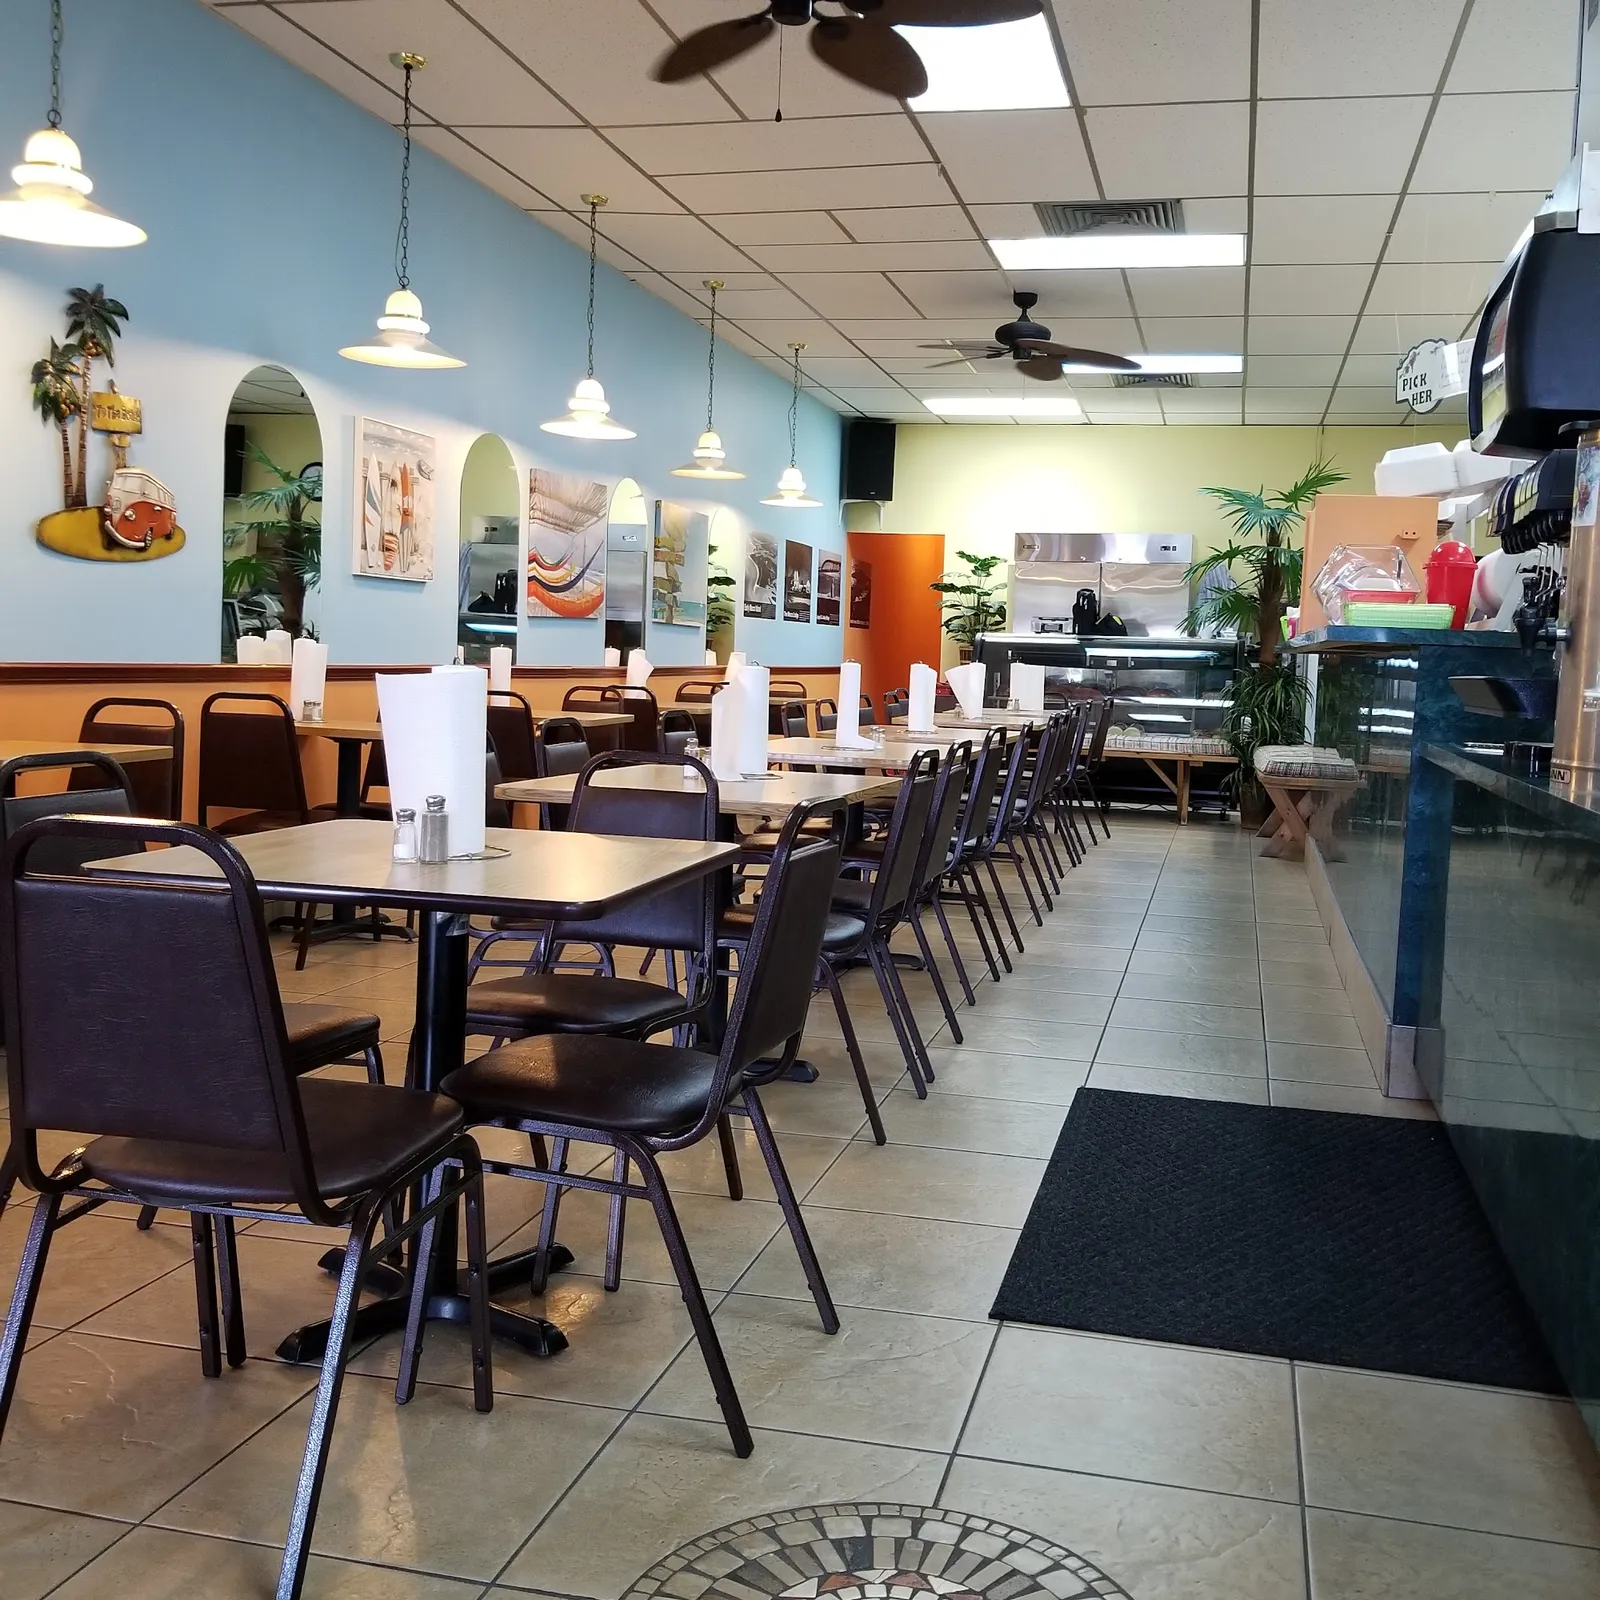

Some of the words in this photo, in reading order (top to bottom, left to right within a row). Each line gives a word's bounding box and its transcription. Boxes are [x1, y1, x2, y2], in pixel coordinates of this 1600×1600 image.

[1402, 372, 1427, 392] PICK
[1411, 389, 1432, 406] HER
[121, 406, 140, 422] Bea
